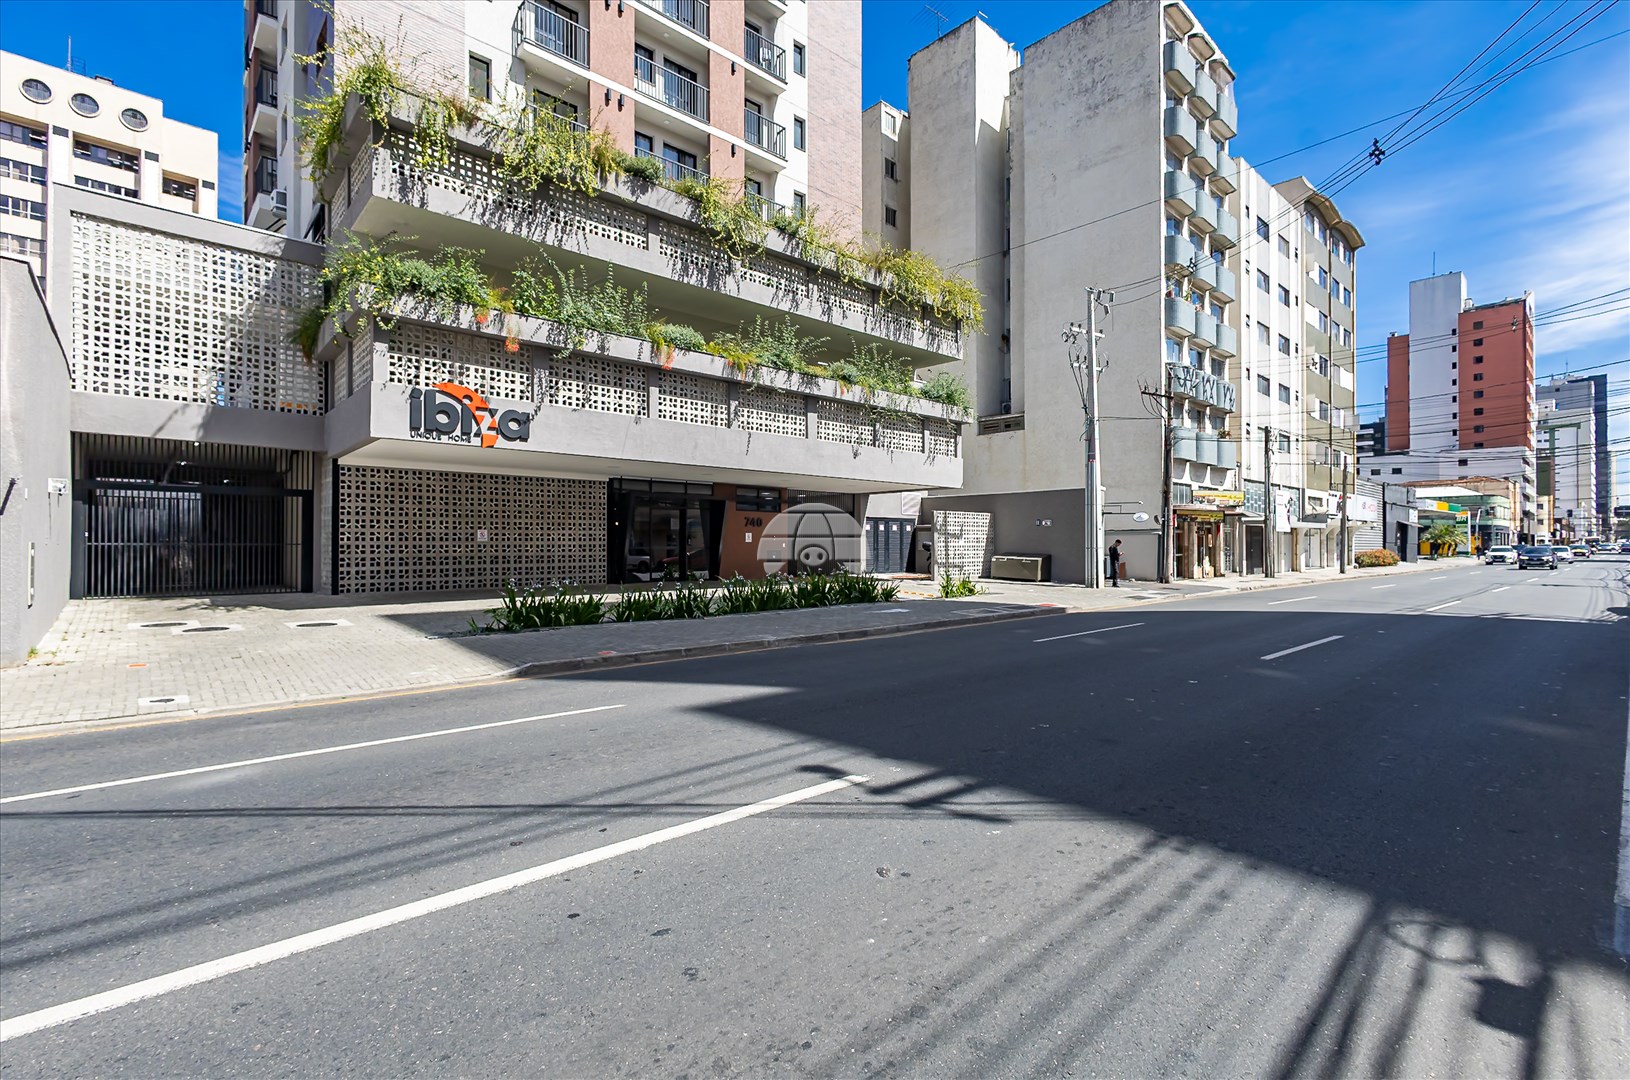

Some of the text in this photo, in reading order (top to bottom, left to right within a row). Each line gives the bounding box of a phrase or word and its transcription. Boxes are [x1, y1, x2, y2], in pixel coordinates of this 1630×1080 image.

[409, 384, 531, 446] ibiza
[410, 430, 472, 443] UNIQUE HOME
[744, 516, 763, 528] 740
